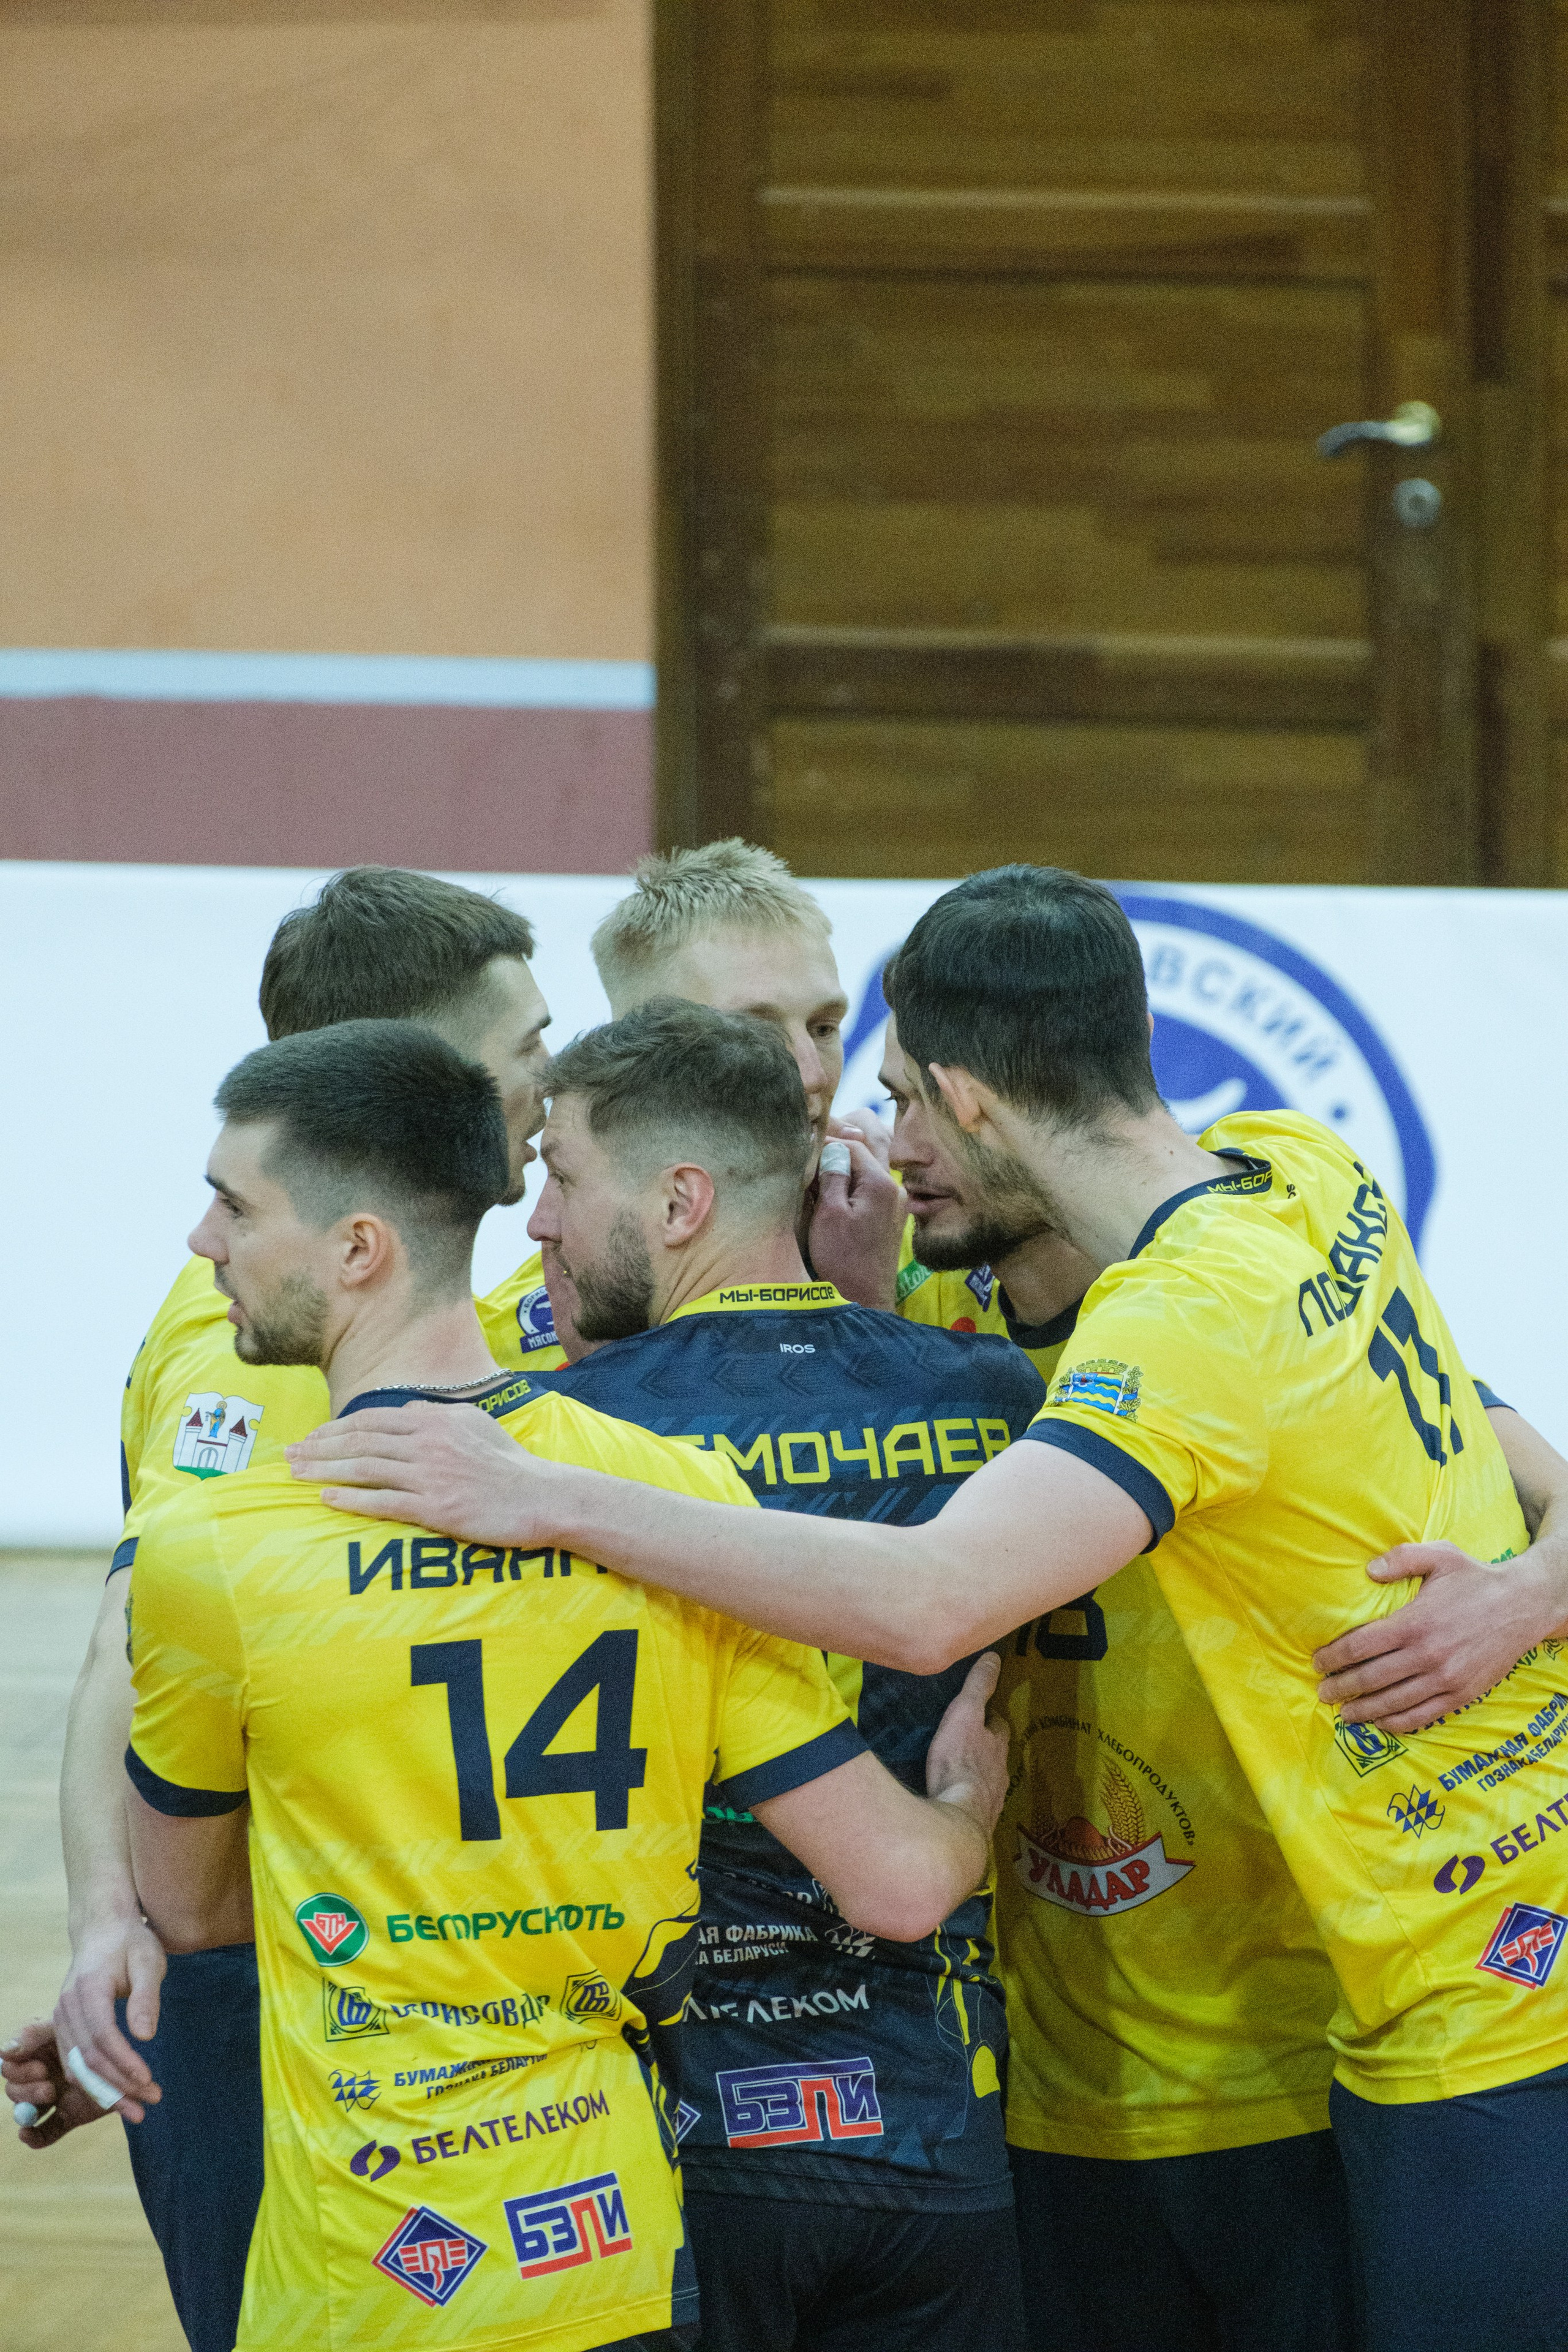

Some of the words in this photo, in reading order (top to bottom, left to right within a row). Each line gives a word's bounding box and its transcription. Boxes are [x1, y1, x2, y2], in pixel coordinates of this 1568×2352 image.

[1147, 945, 1343, 1084] ВСКИЙ
[720, 1286, 835, 1303] МЫ-БОРИСОВ
[780, 1343, 816, 1354] IROS
[473, 1379, 532, 1412] ОРИСОВ
[663, 1419, 1011, 1485] МОЧАЕВ
[410, 1629, 647, 1841] 14
[1490, 1793, 1568, 1865] БЕЛТ
[726, 1924, 818, 1943] ФАБРИКА
[412, 2089, 610, 2165] БЕЛТЕЛЕКОМ
